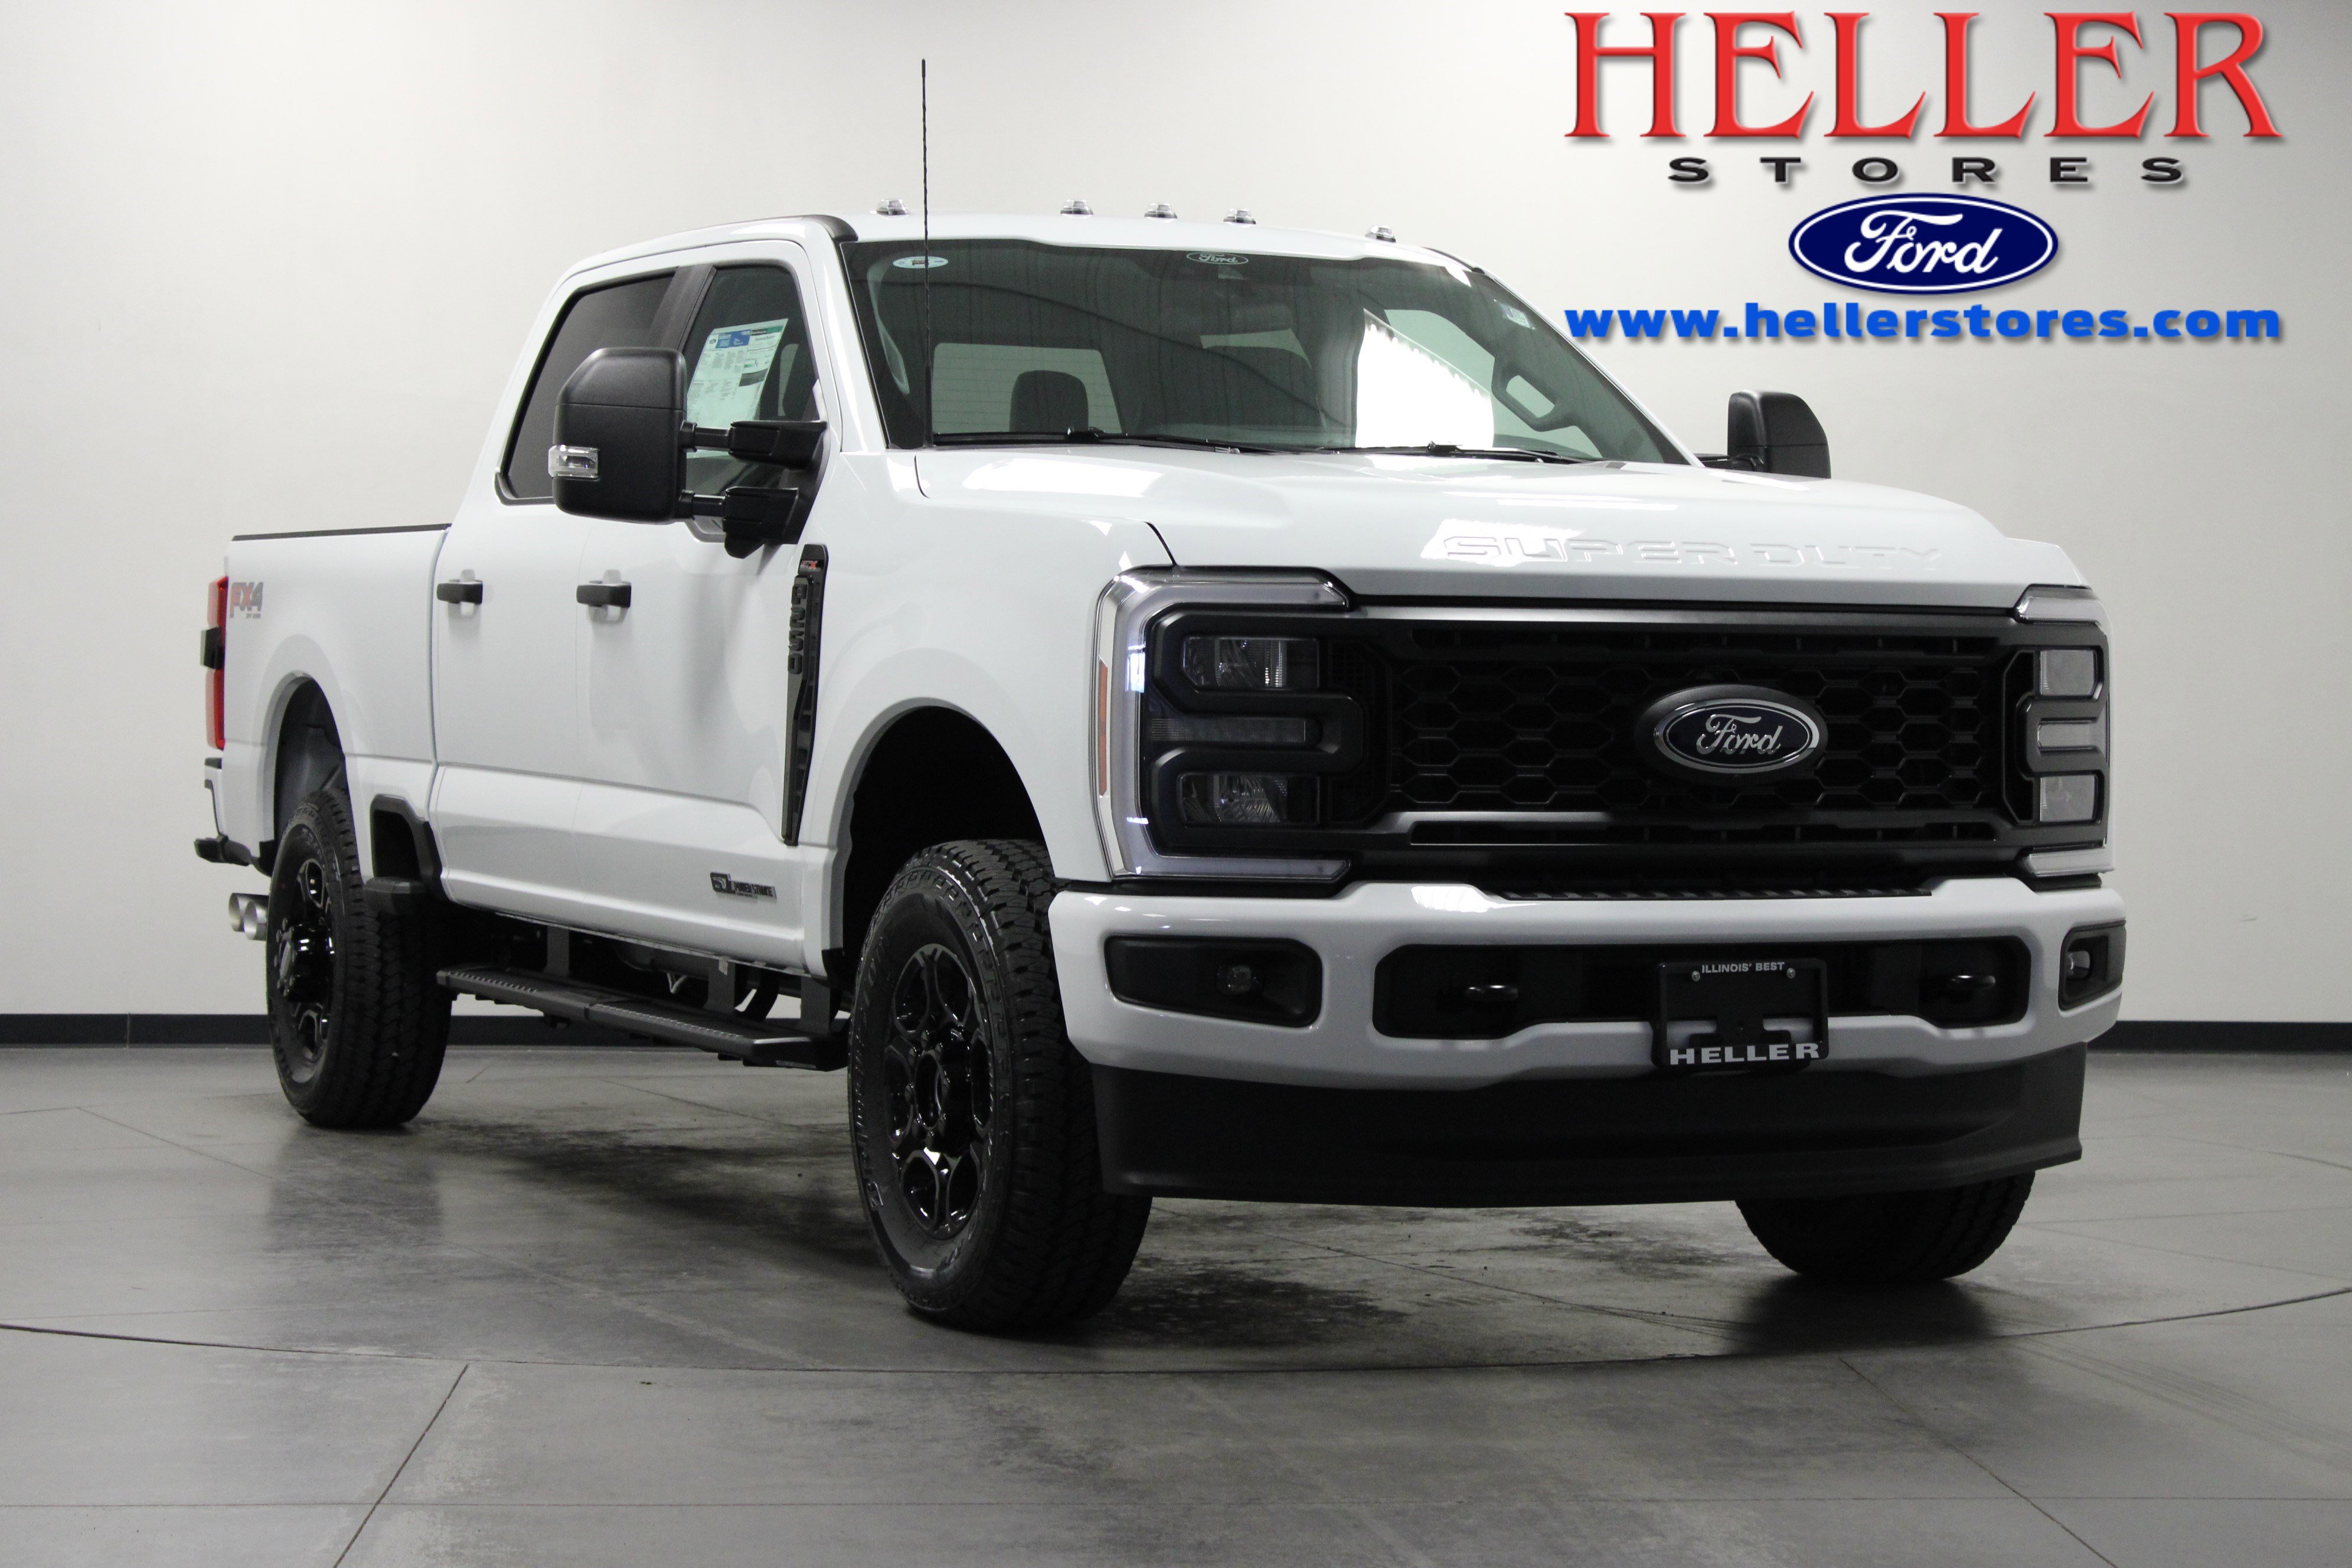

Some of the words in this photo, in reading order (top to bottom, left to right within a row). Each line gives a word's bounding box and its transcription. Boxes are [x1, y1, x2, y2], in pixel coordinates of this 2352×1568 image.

[1198, 253, 1238, 263] Ford
[1443, 536, 1739, 565] SUPER
[1750, 543, 1940, 570] DUTY
[1696, 714, 1783, 755] Ford
[1701, 963, 1752, 974] ILLINOIS'
[1755, 962, 1785, 971] BEST
[1670, 1043, 1819, 1066] HELLER
